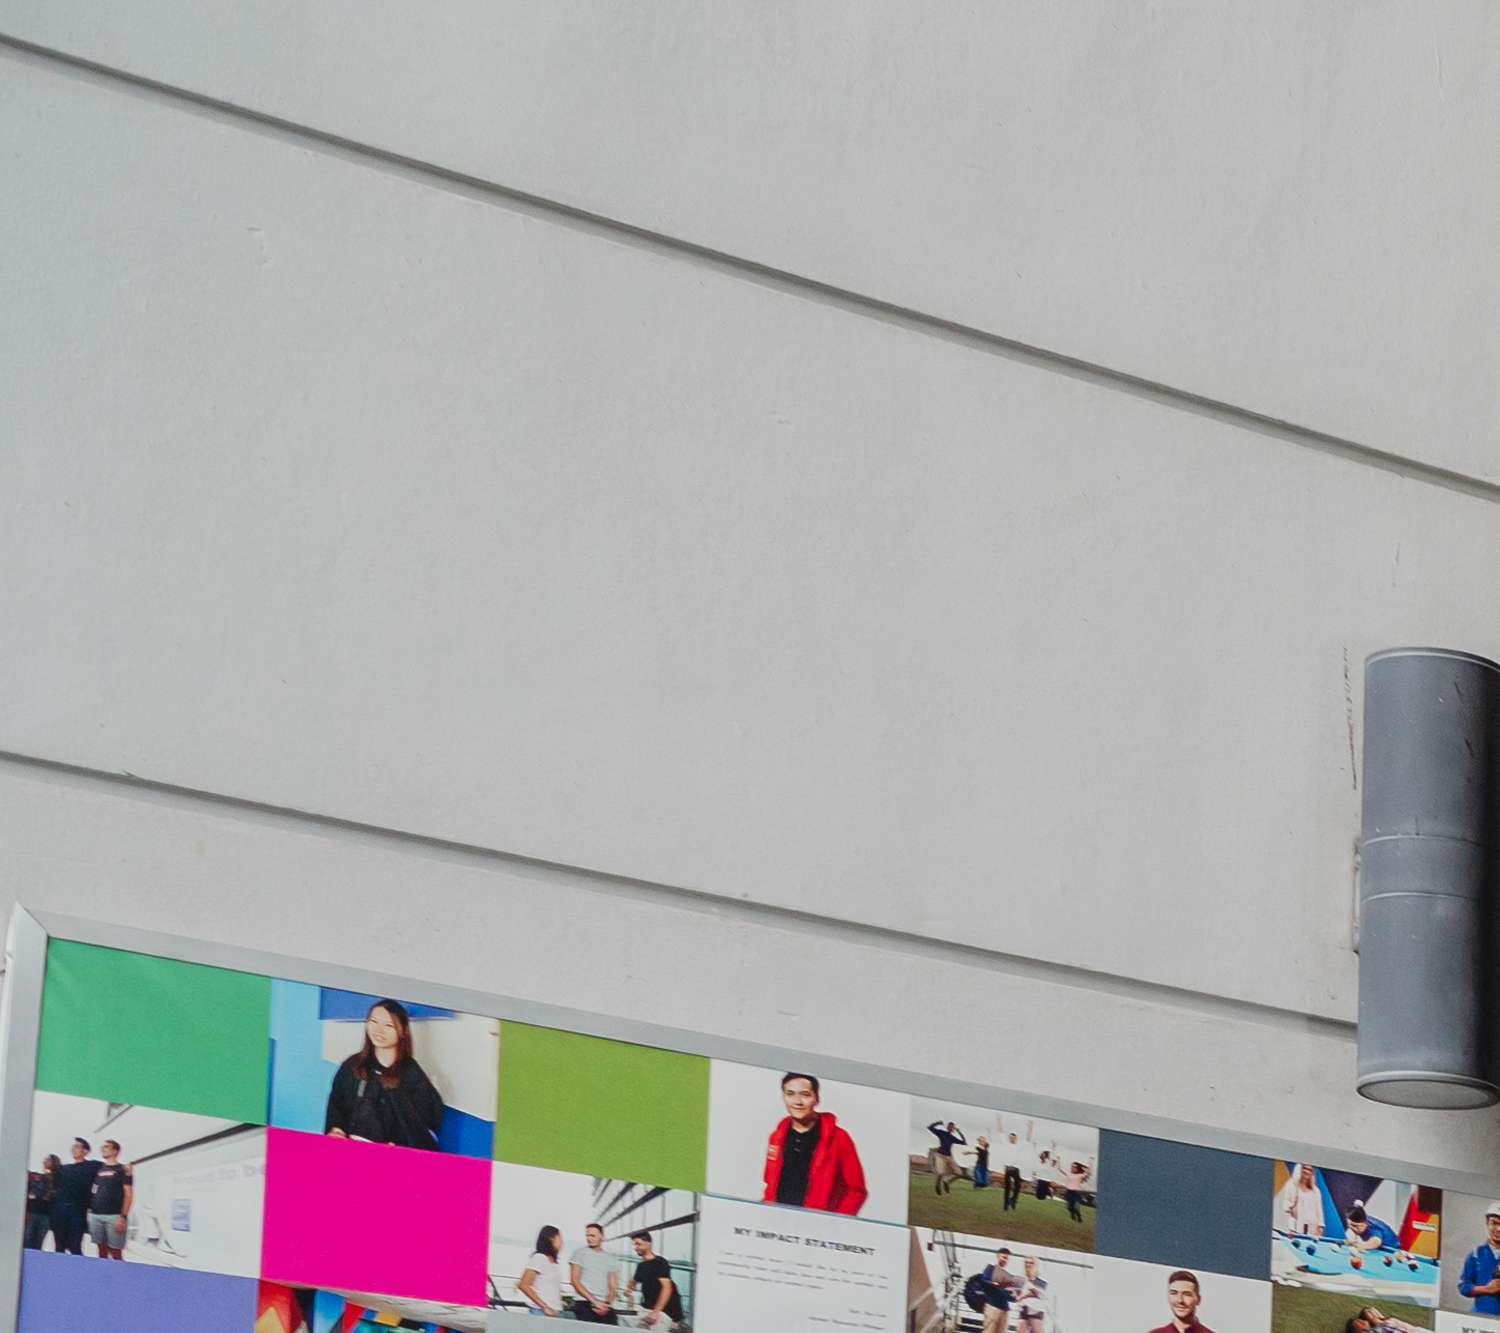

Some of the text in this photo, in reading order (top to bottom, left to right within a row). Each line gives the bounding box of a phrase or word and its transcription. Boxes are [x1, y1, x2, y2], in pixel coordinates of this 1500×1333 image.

[734, 1228, 875, 1255] MY IMPACT STATEMENT
